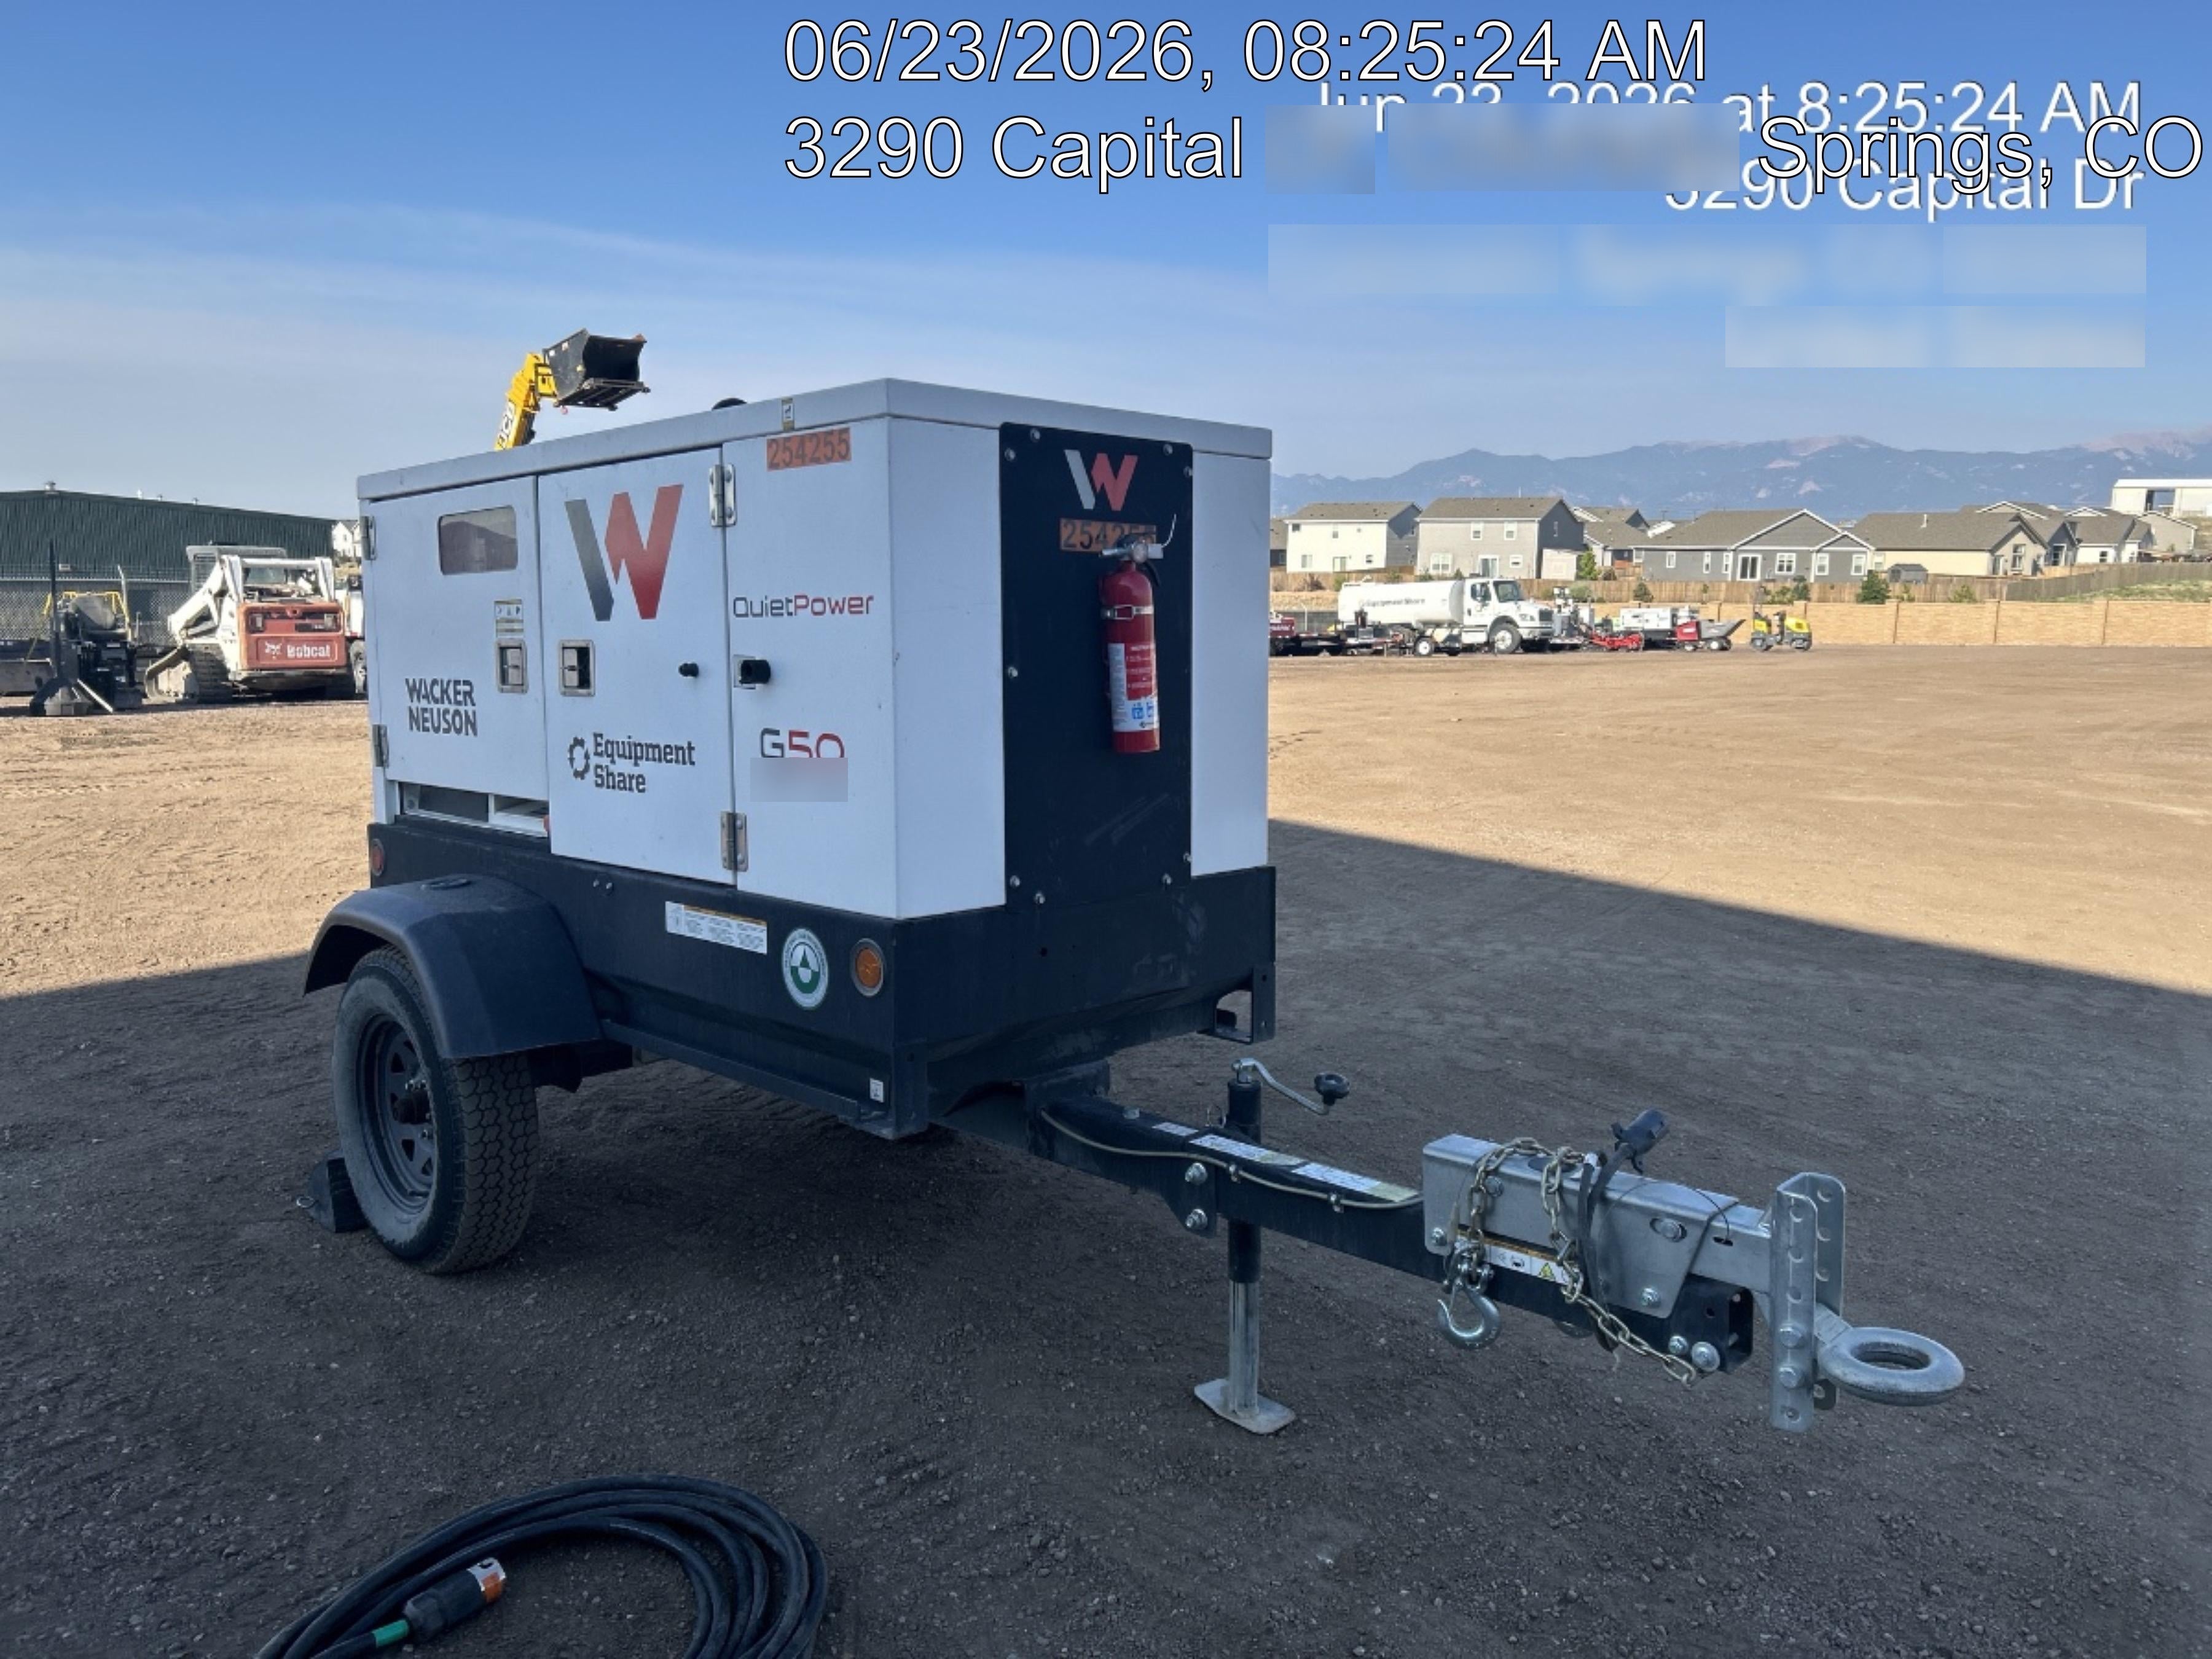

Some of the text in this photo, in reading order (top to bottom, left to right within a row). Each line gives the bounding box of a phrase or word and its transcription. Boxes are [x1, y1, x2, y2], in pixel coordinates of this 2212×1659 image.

[768, 428, 850, 470] 254255
[733, 594, 874, 618] QuietPower
[287, 643, 331, 659] Bobcat
[405, 678, 476, 706] WACKER
[409, 706, 477, 737] NEUSON
[593, 732, 696, 767] Equipment
[594, 764, 646, 793] Share
